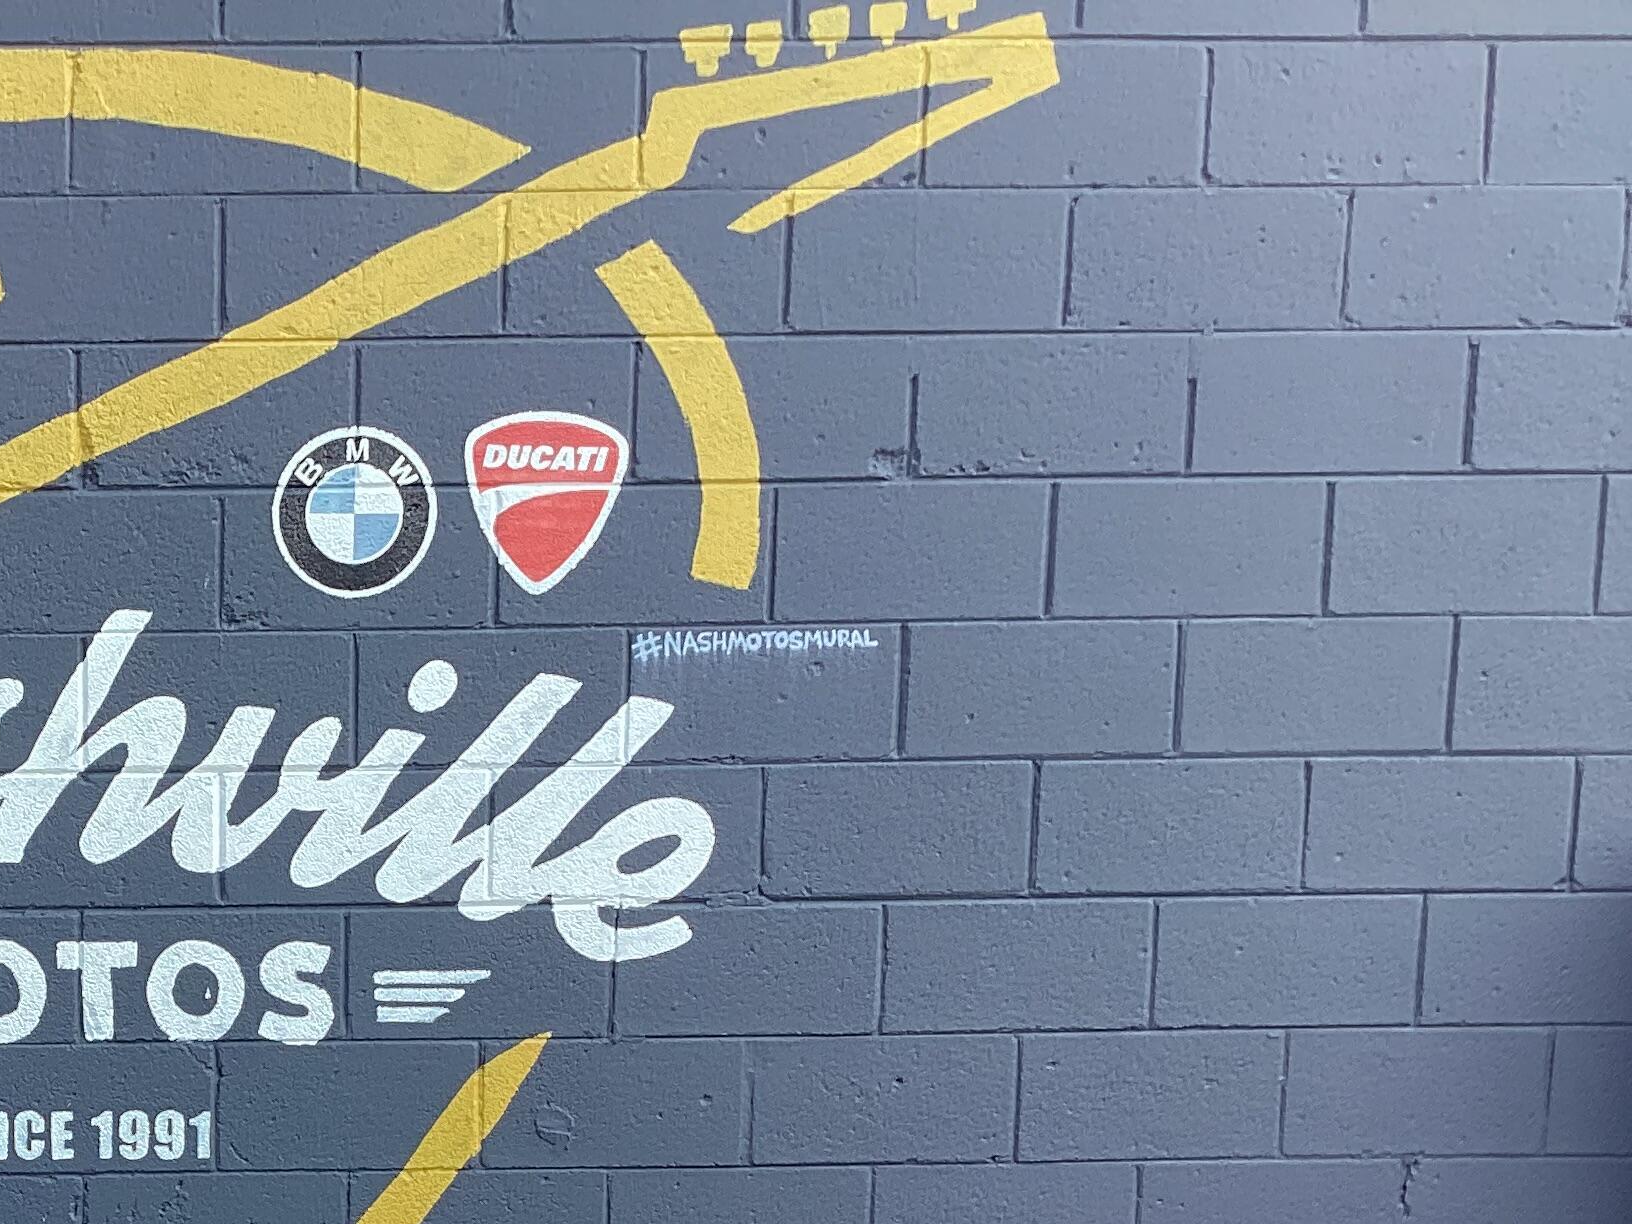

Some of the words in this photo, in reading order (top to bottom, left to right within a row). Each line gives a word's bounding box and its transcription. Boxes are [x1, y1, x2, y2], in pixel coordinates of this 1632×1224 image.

[292, 437, 421, 488] BMW
[482, 443, 610, 472] DUCATI
[631, 628, 879, 661] #NASHMOTOSMURAL
[90, 1109, 212, 1160] 1991
